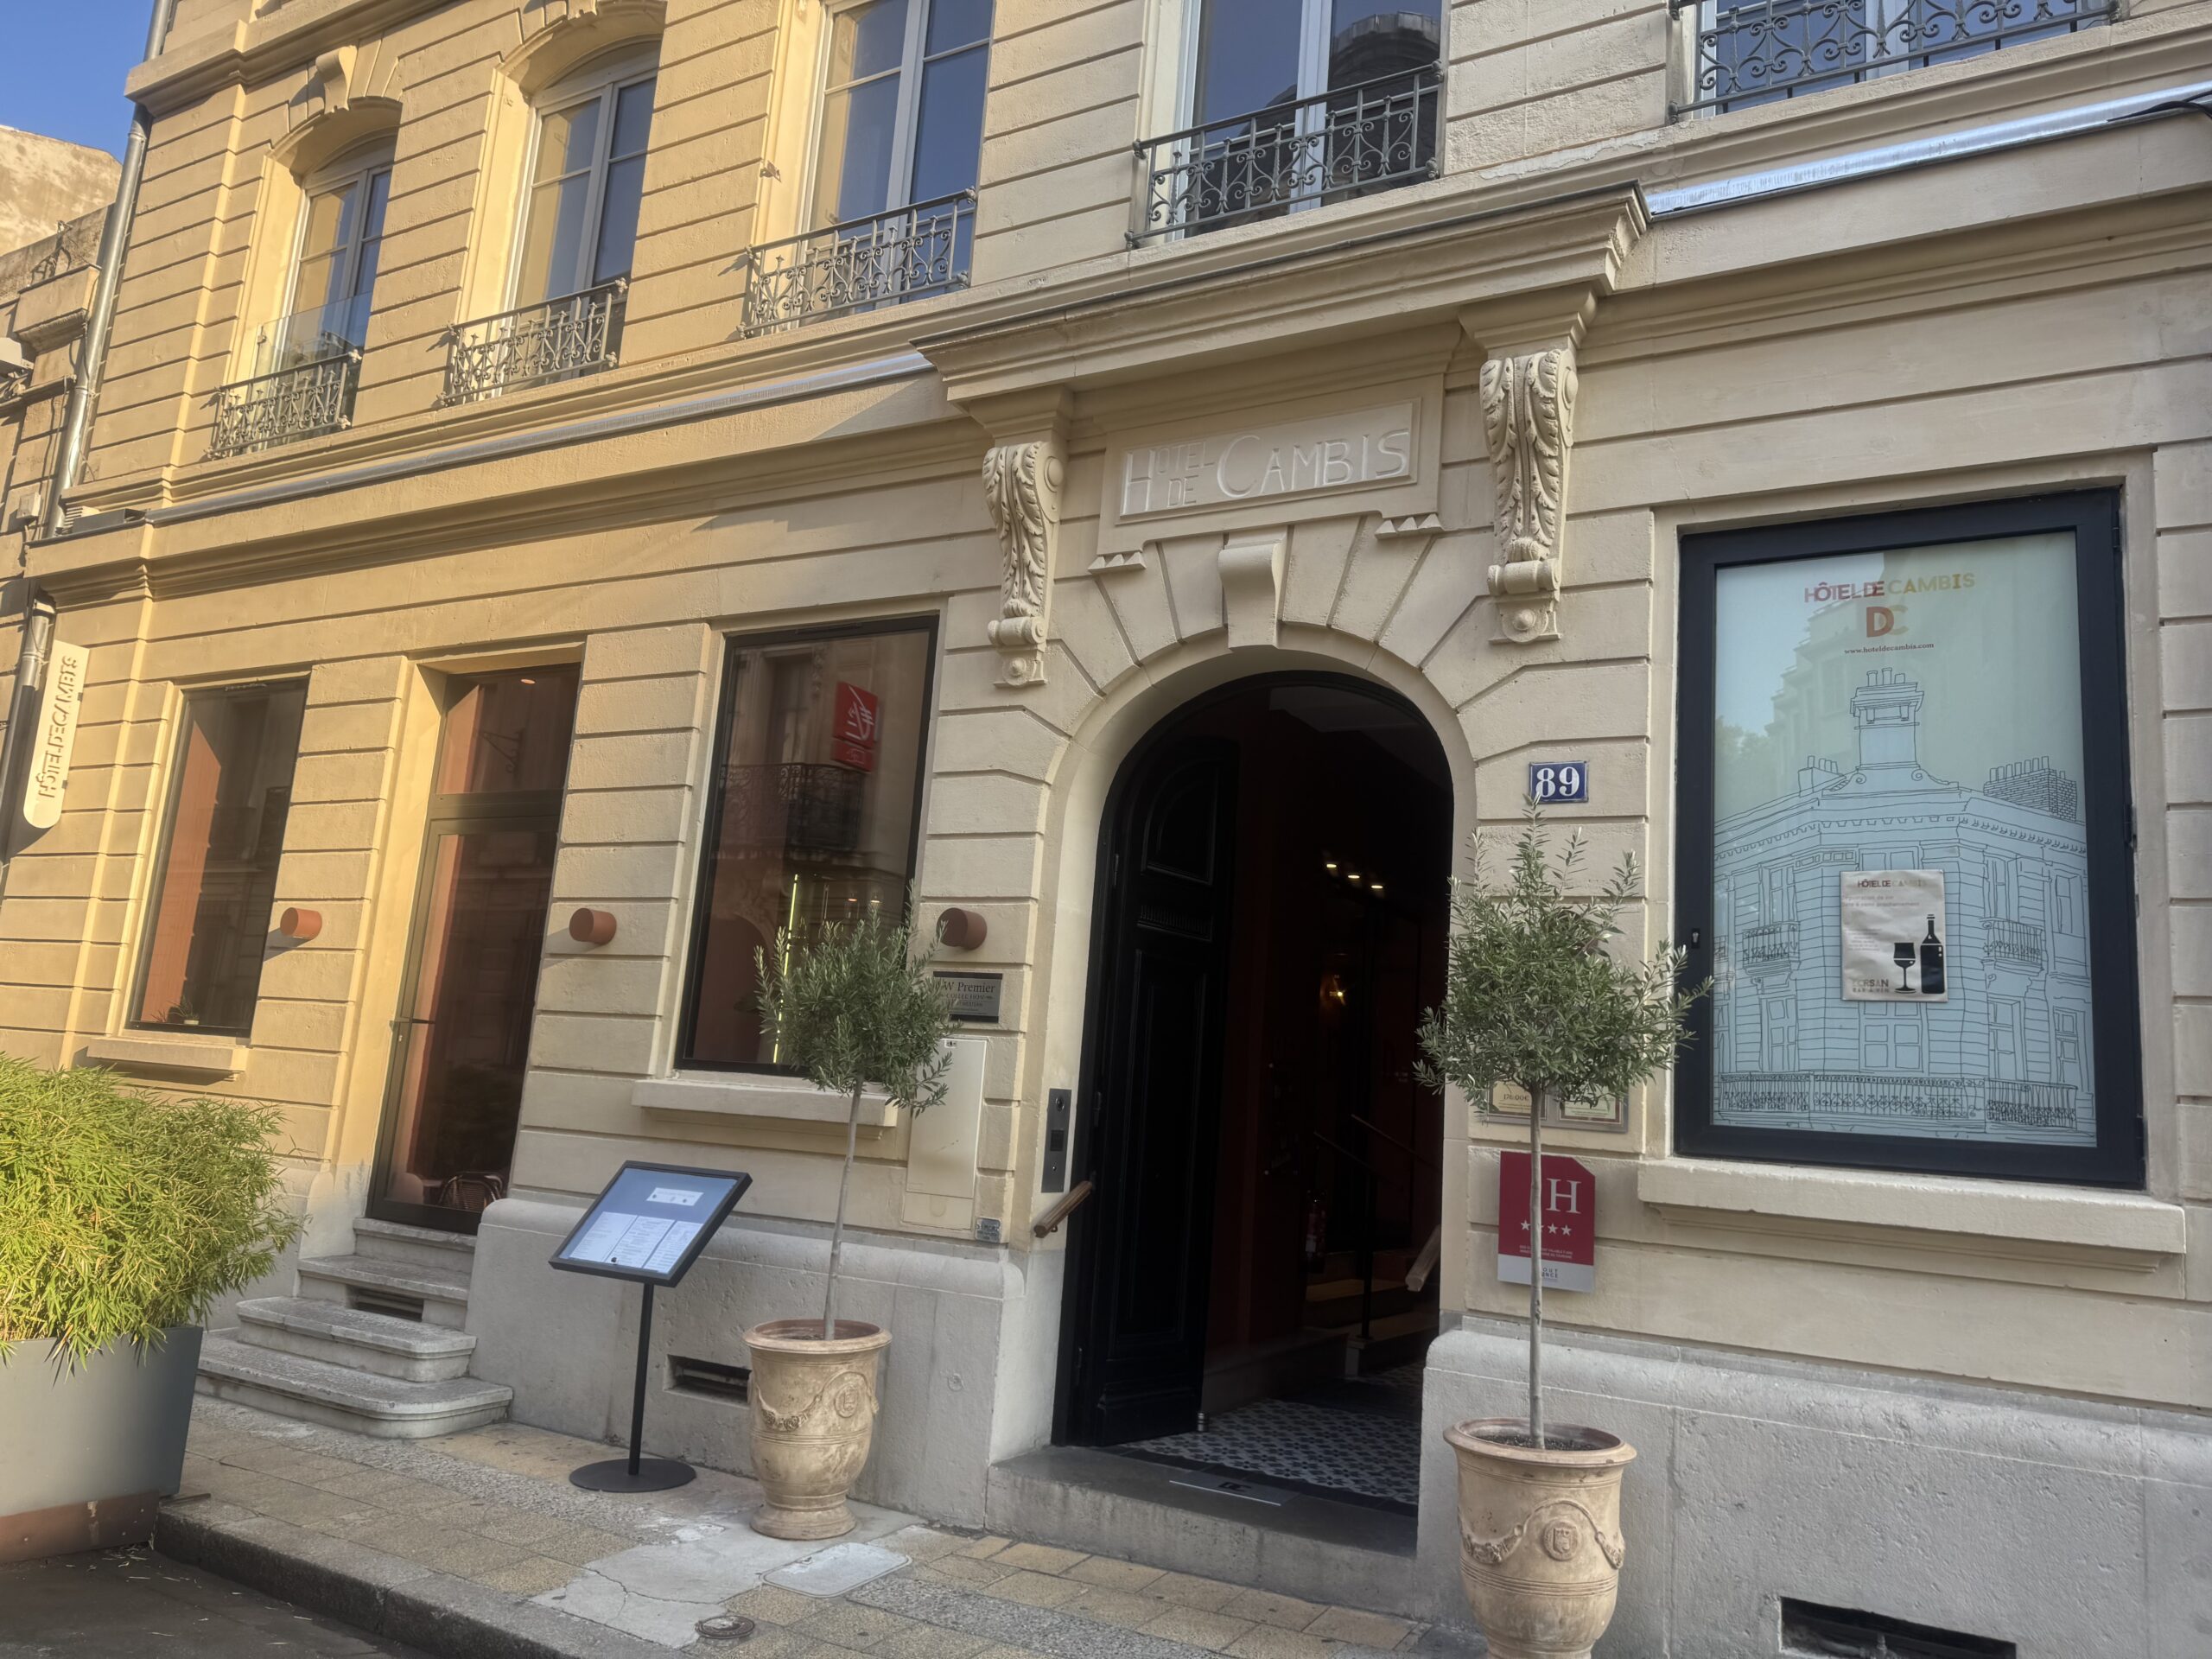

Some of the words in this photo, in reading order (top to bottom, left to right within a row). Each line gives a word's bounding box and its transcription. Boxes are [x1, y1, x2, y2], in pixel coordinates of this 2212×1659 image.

[1217, 429, 1409, 498] CAMBIS
[1166, 474, 1199, 508] DE
[1887, 573, 1976, 595] CAMBIS
[1844, 643, 1935, 655] www.hoteldecambis.com
[53, 655, 78, 727] CAMBIS
[1535, 766, 1580, 798] 89
[957, 981, 996, 993] Premier
[1545, 1178, 1581, 1215] H
